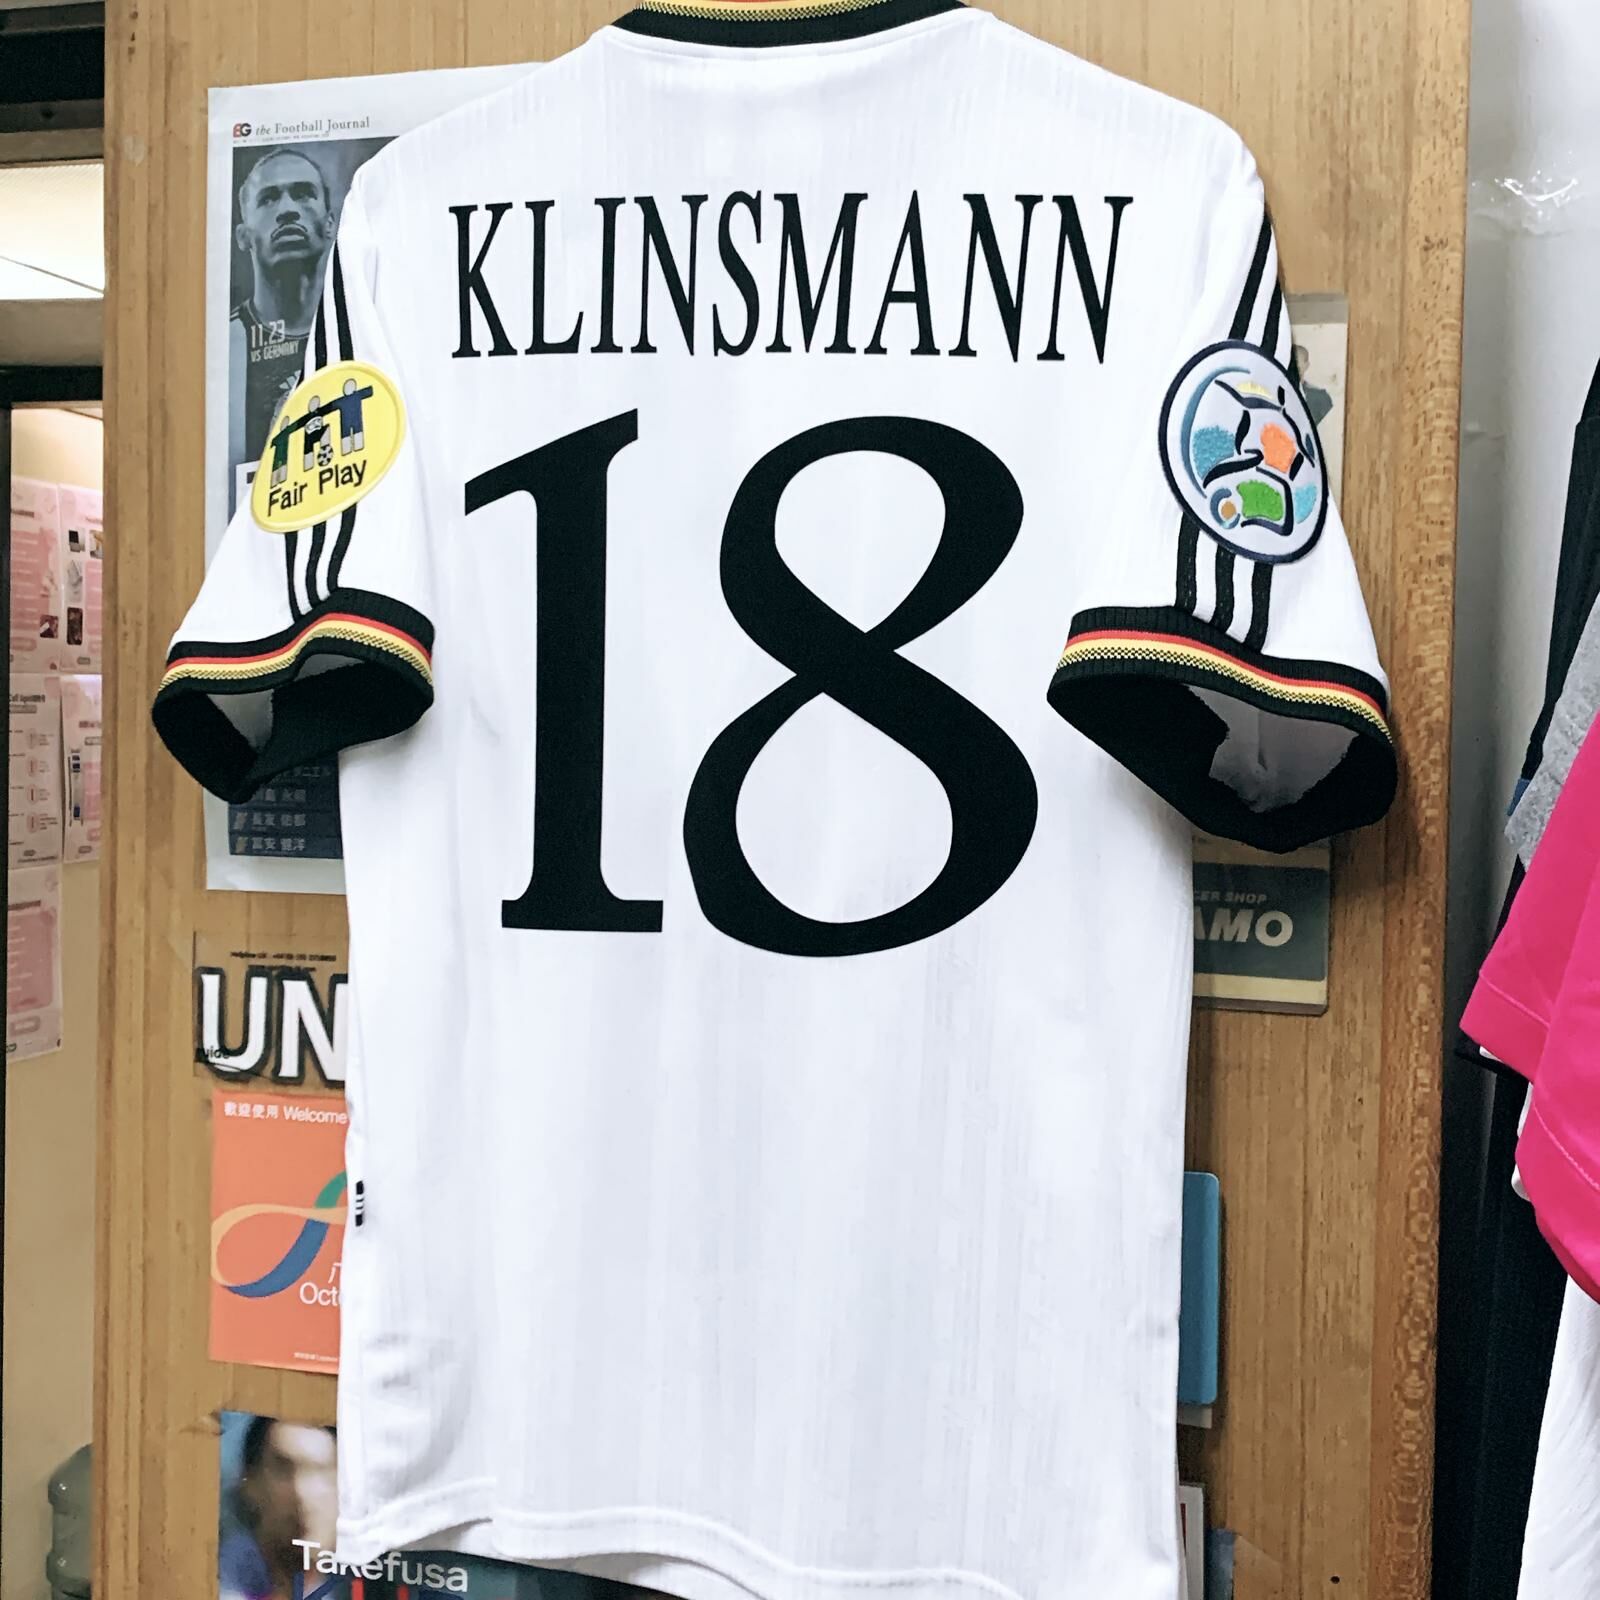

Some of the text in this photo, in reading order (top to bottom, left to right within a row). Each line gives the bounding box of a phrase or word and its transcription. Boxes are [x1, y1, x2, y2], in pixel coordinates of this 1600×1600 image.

[256, 124, 271, 136] the
[275, 119, 323, 135] Football
[327, 116, 370, 134] Journal
[449, 190, 1134, 363] KLINSMANN
[251, 320, 285, 349] 11.23
[251, 340, 300, 363] VS GERMANY
[267, 459, 367, 517] Fair Play
[465, 408, 1038, 957] 18
[1225, 891, 1267, 905] SHOP
[283, 1105, 348, 1125] Welcome
[300, 1281, 341, 1307] Oct
